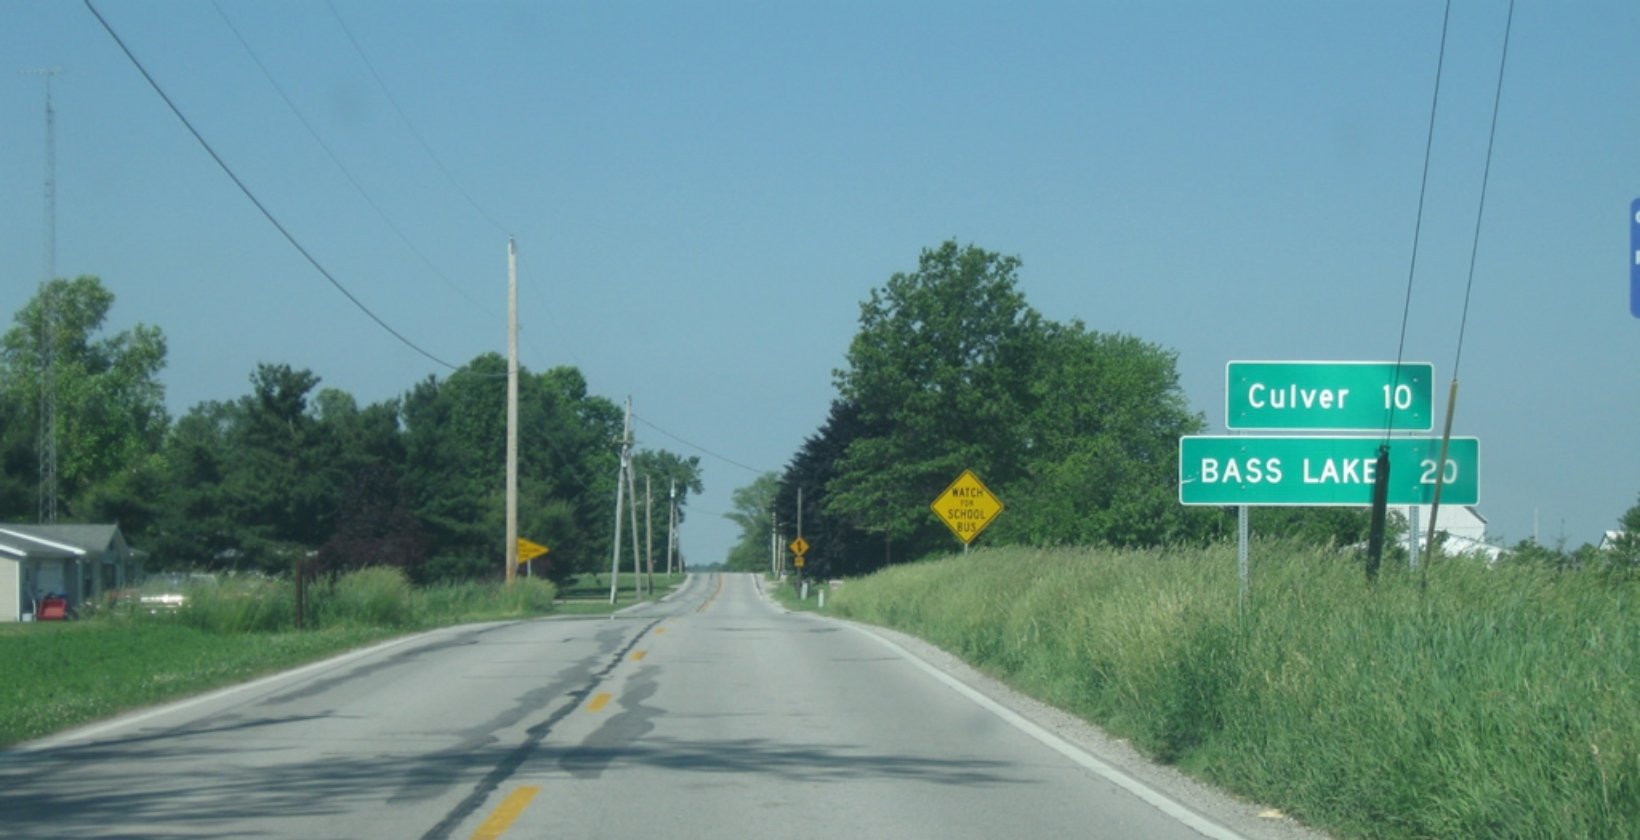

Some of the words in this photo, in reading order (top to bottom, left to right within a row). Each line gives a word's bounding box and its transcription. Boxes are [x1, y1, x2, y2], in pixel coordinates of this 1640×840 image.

[1248, 383, 1349, 409] Culver
[1382, 384, 1412, 409] 10
[1201, 458, 1283, 484] BASS
[1303, 458, 1378, 484] LAKE
[1419, 459, 1458, 484] 20
[952, 487, 983, 498] WATCH
[960, 499, 974, 507] FOR
[947, 508, 986, 520] SCHOOL
[957, 521, 976, 532] BUS
